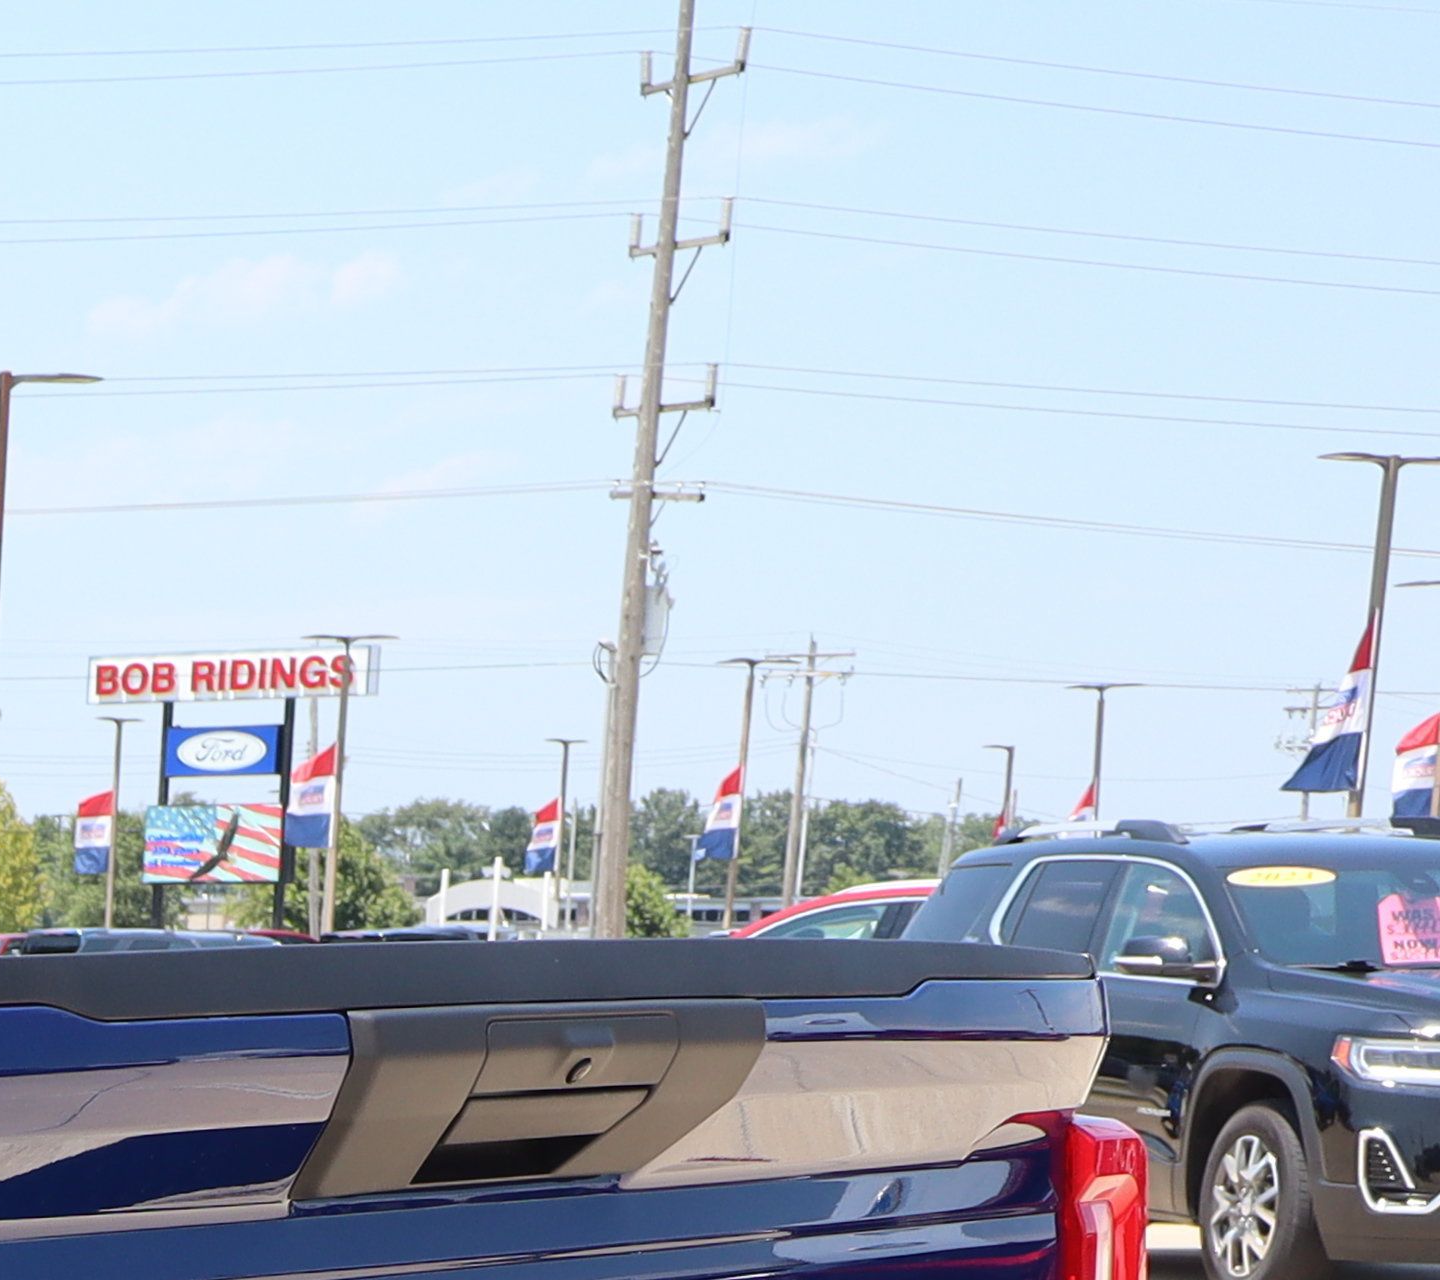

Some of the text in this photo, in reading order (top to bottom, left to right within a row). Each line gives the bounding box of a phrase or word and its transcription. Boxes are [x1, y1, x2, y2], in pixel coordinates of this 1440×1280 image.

[96, 655, 355, 695] BOB RIDINGS
[195, 736, 249, 762] Ford
